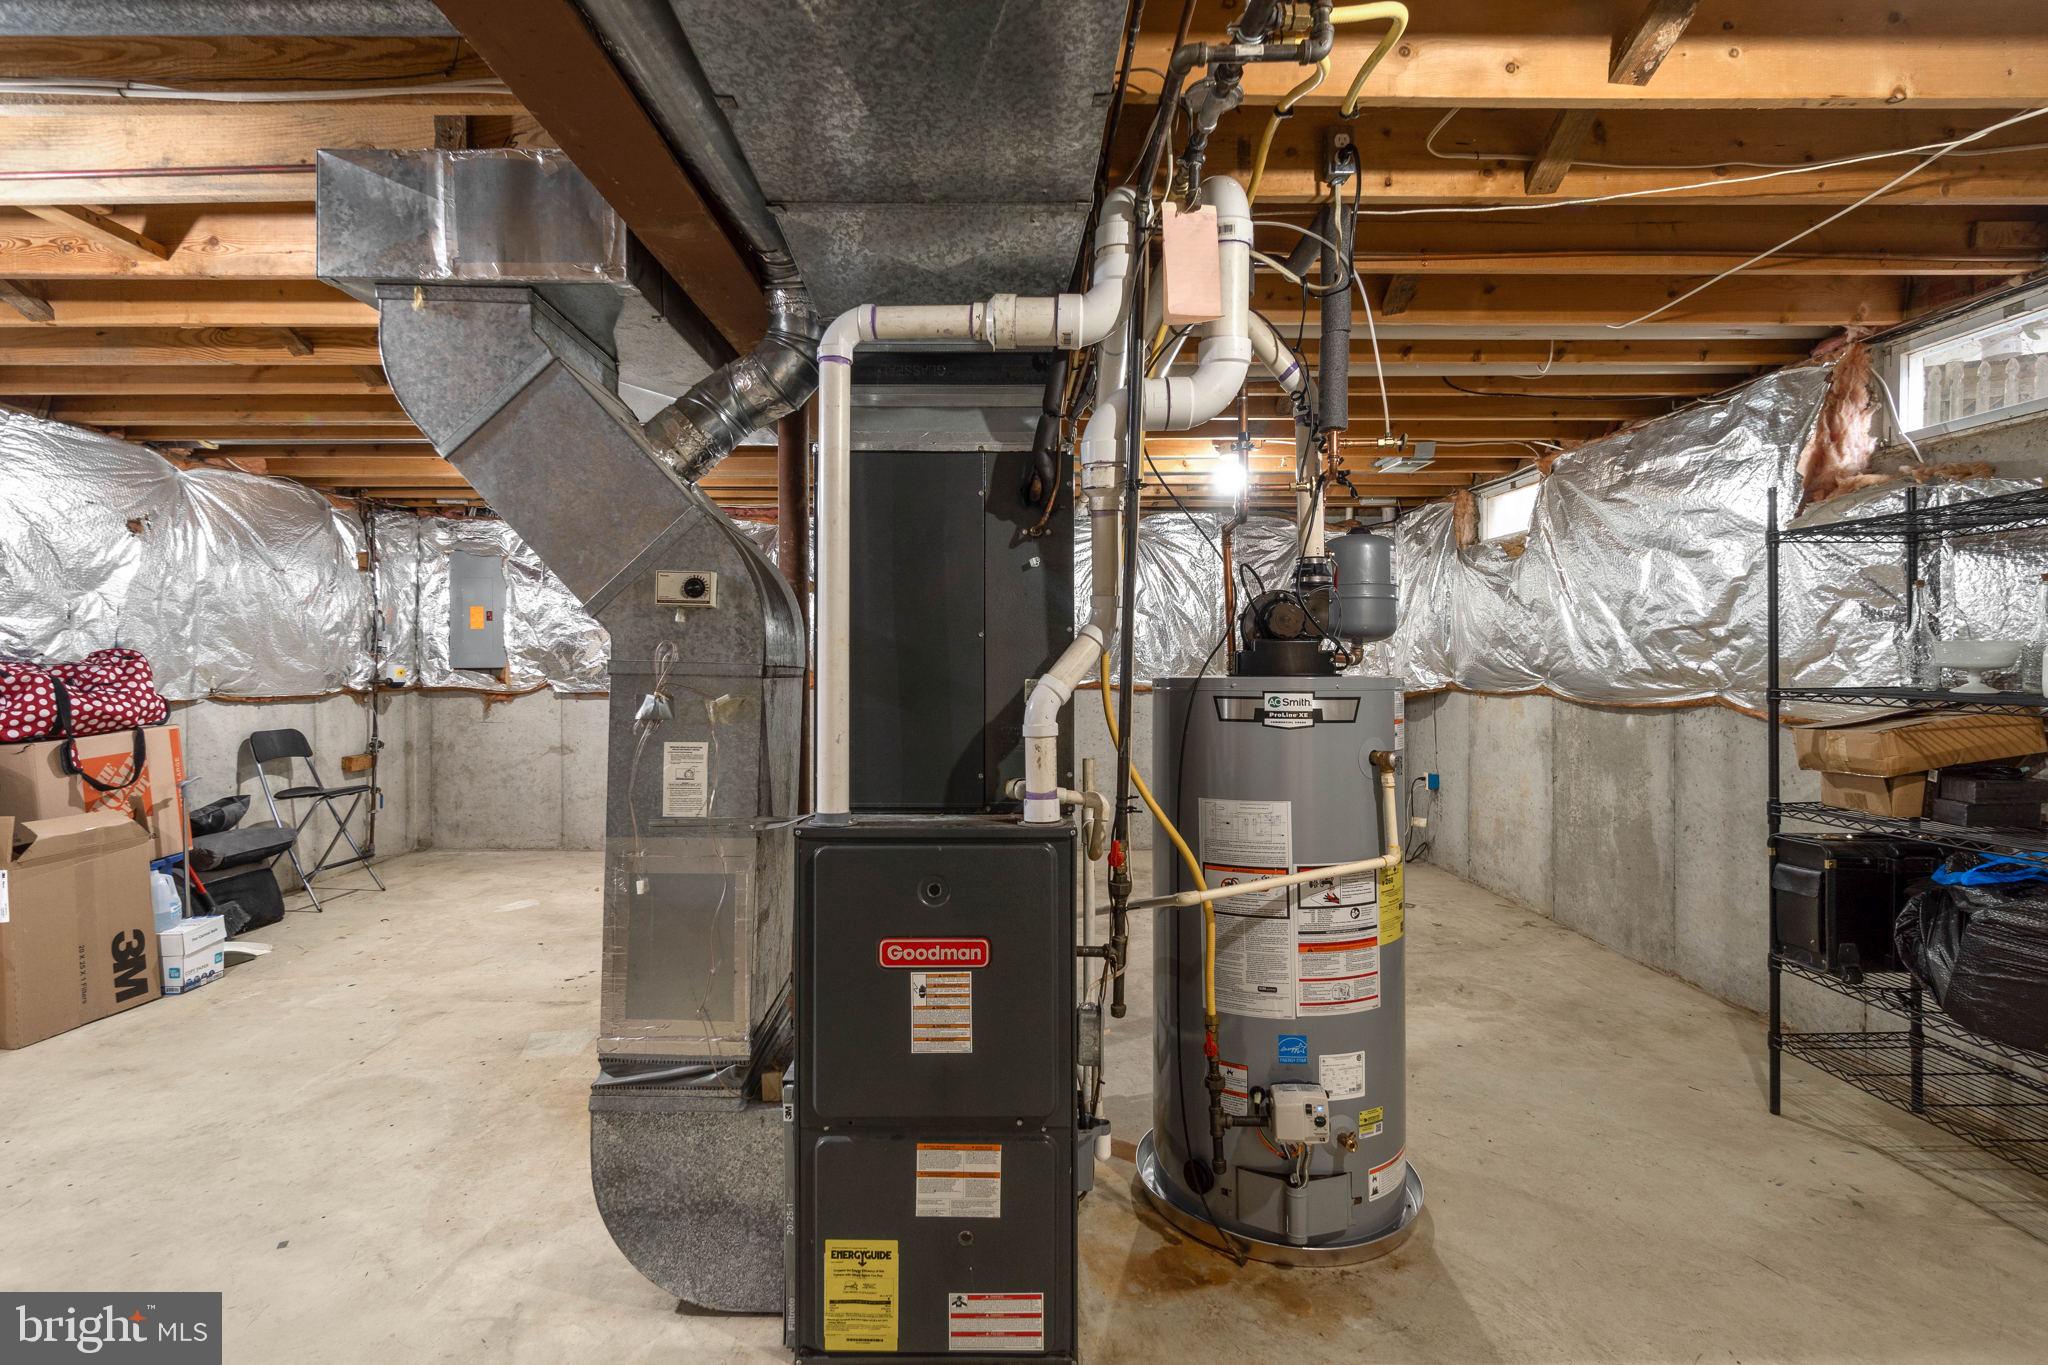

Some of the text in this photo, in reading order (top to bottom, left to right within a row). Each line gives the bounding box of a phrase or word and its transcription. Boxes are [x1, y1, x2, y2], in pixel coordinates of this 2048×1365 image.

[1282, 697, 1311, 707] Smith
[78, 944, 86, 953] 20
[886, 943, 983, 962] Goodman
[111, 929, 149, 1003] 3M
[785, 1106, 792, 1120] 3M
[831, 1250, 892, 1261] ENERGYGUIDE
